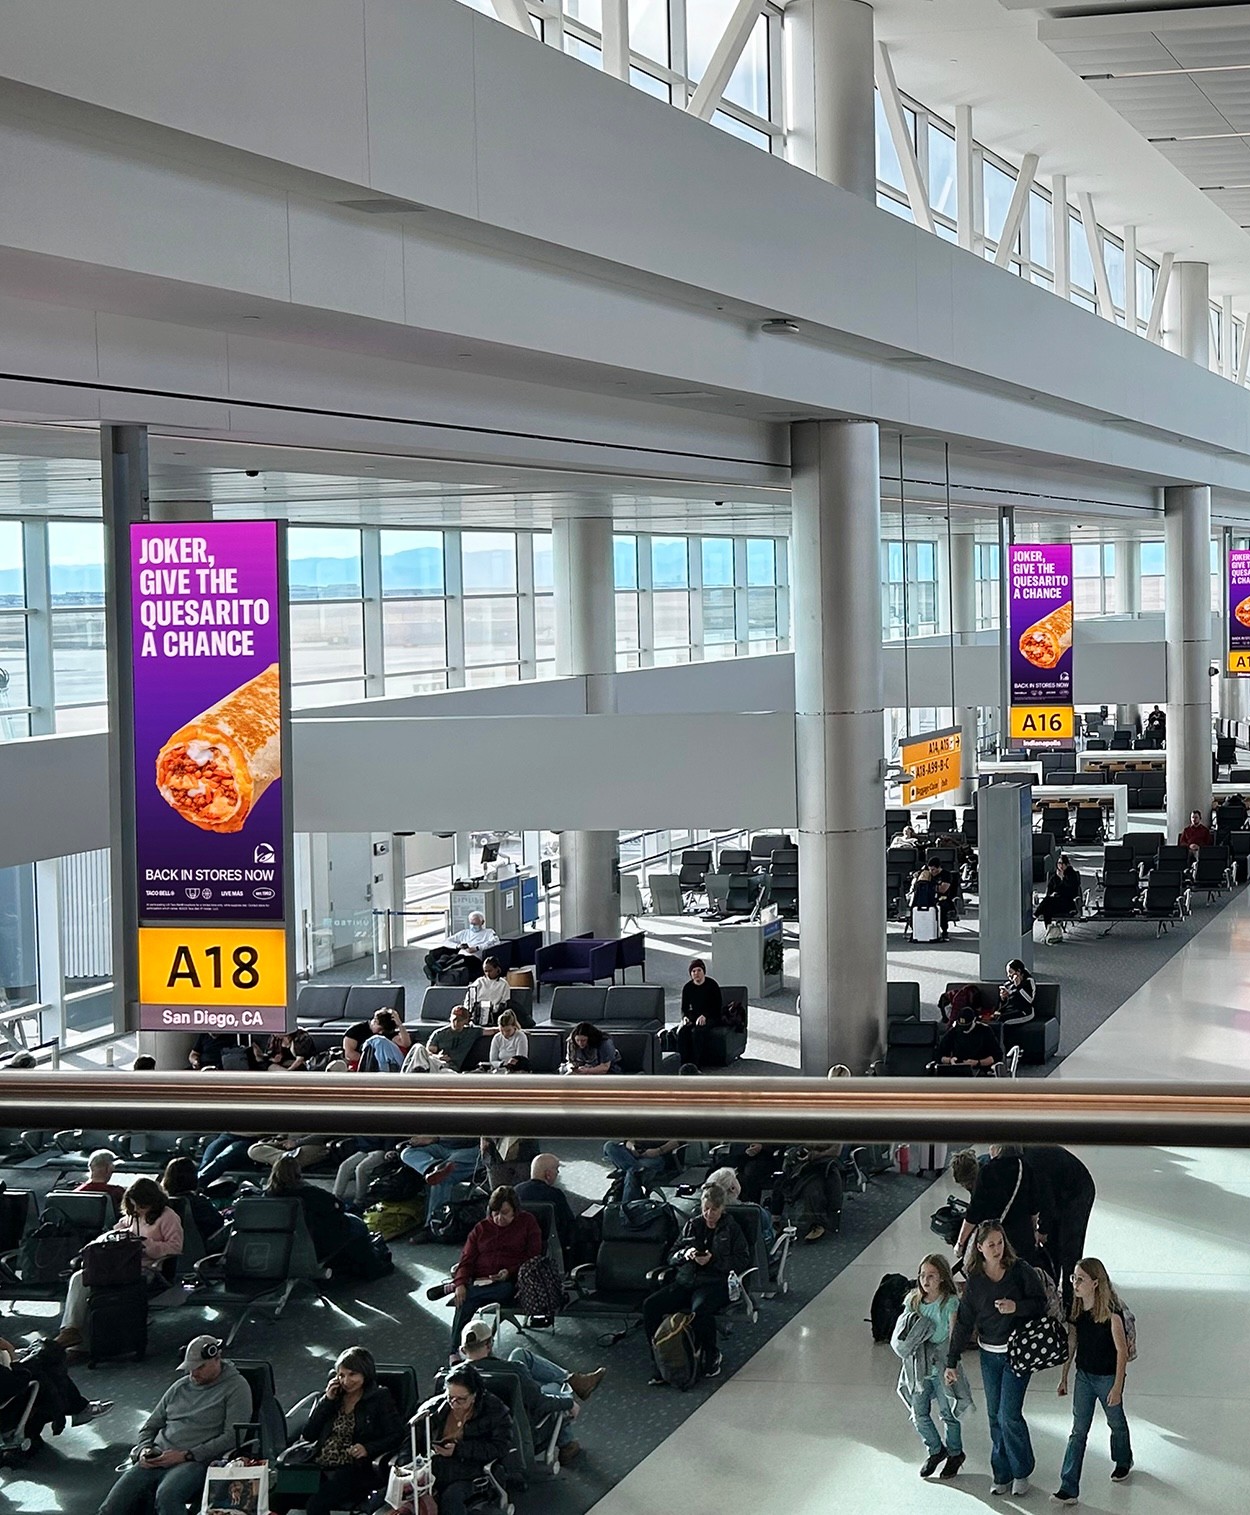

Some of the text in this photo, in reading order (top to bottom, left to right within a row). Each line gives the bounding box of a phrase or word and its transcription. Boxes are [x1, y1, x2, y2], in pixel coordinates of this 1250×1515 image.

[139, 538, 215, 568] JOKER,
[1013, 551, 1045, 563] JOKER,
[1013, 563, 1055, 574] GIVE THE
[1232, 561, 1247, 569] GIVE
[140, 567, 238, 595] GIVE THE
[1014, 575, 1068, 588] QUESARITO
[1014, 588, 1061, 599] A CHANCE
[140, 599, 269, 630] QUESARITO
[141, 630, 254, 657] A CHANCE
[1023, 714, 1061, 731] A16
[146, 869, 274, 881] BACK IN STORES NOW
[167, 946, 259, 989] A18
[163, 1010, 263, 1028] San Diego, CA
